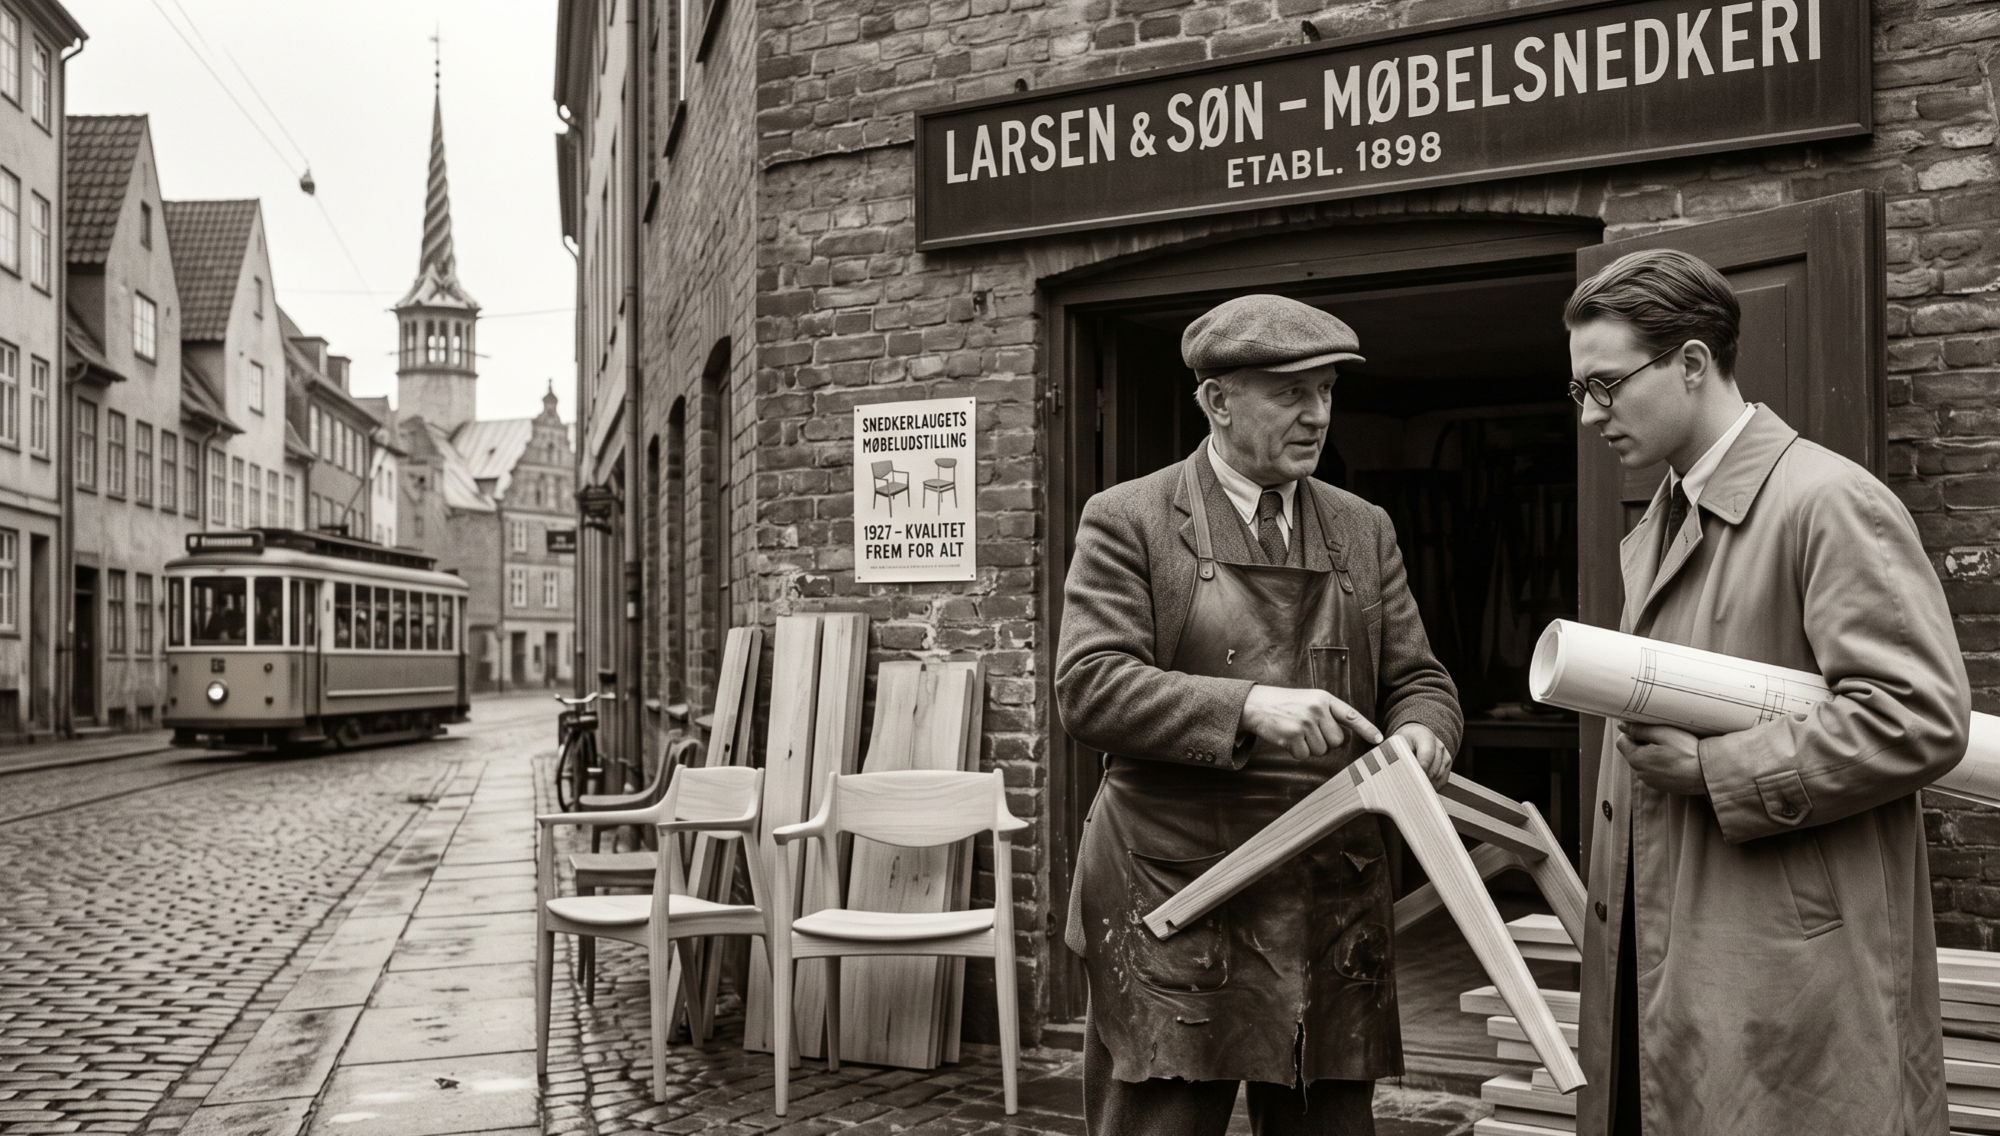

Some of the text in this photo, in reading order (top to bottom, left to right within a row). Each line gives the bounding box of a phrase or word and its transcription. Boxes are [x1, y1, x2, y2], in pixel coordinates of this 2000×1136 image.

[946, 105, 1116, 184] LARSEN
[1130, 111, 1157, 158] &
[1166, 80, 1263, 153] SØN
[1324, 0, 1821, 131] MØBELSNEDKERI
[1227, 131, 1442, 189] ETABL. 1898
[862, 411, 967, 433] SNEDKERLAUGETS
[862, 432, 967, 454] MØBELUDSTILLING
[863, 524, 893, 541] 1927
[905, 522, 966, 540] KVALITET
[866, 541, 964, 560] FREM FOR ALT
